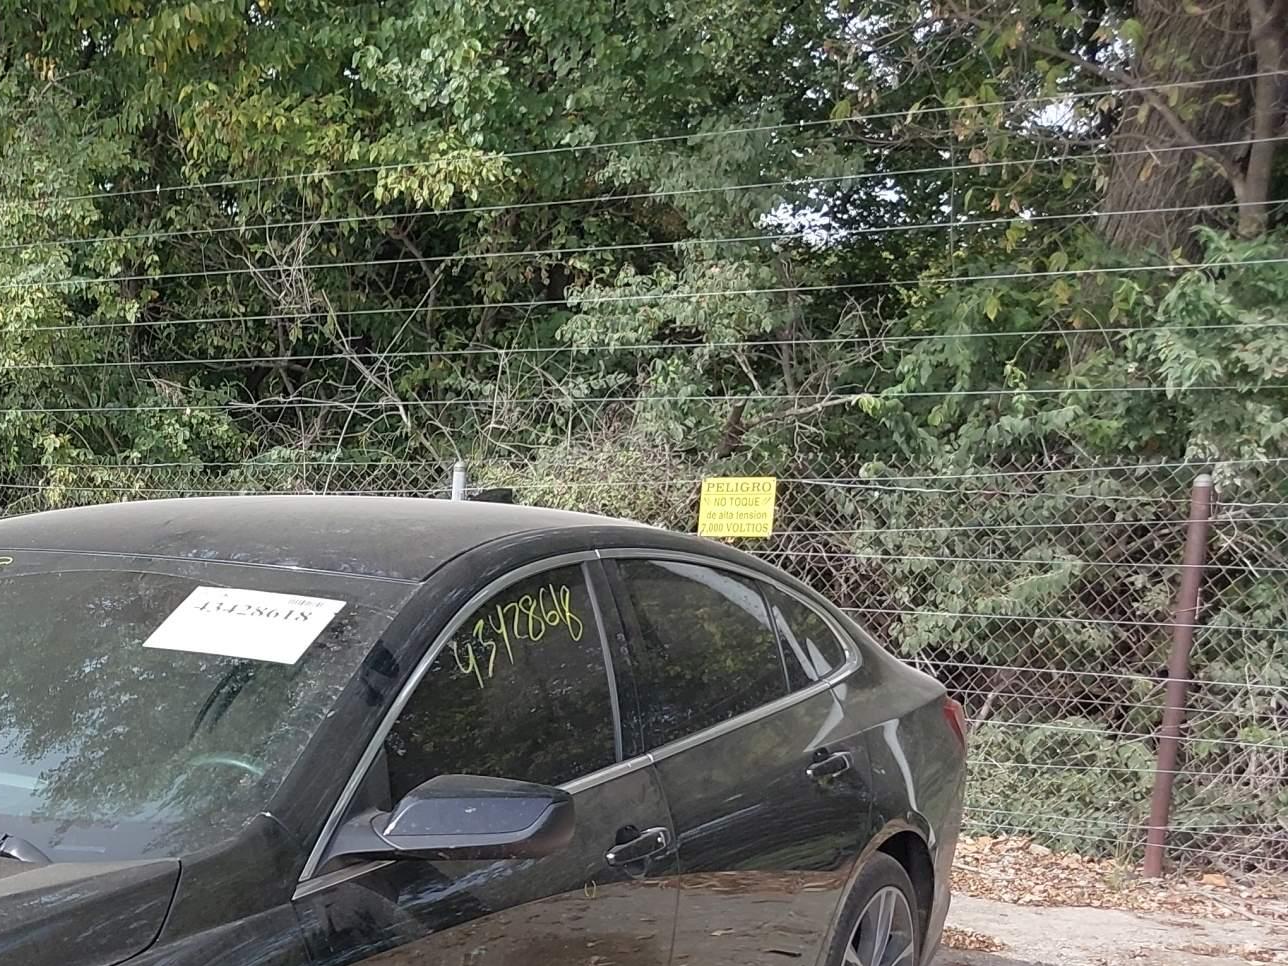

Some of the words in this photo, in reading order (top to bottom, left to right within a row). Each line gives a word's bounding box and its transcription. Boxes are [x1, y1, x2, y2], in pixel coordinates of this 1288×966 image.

[706, 482, 772, 493] PELIGRO
[714, 497, 727, 507] NO
[730, 497, 760, 507] TOQUE
[706, 510, 716, 520] de
[718, 510, 734, 520] alta
[736, 510, 767, 520] tension
[701, 523, 724, 534] 7,000
[726, 522, 769, 533] VOLTIOS
[194, 601, 313, 622] 43428618
[449, 584, 583, 689] 43428618
